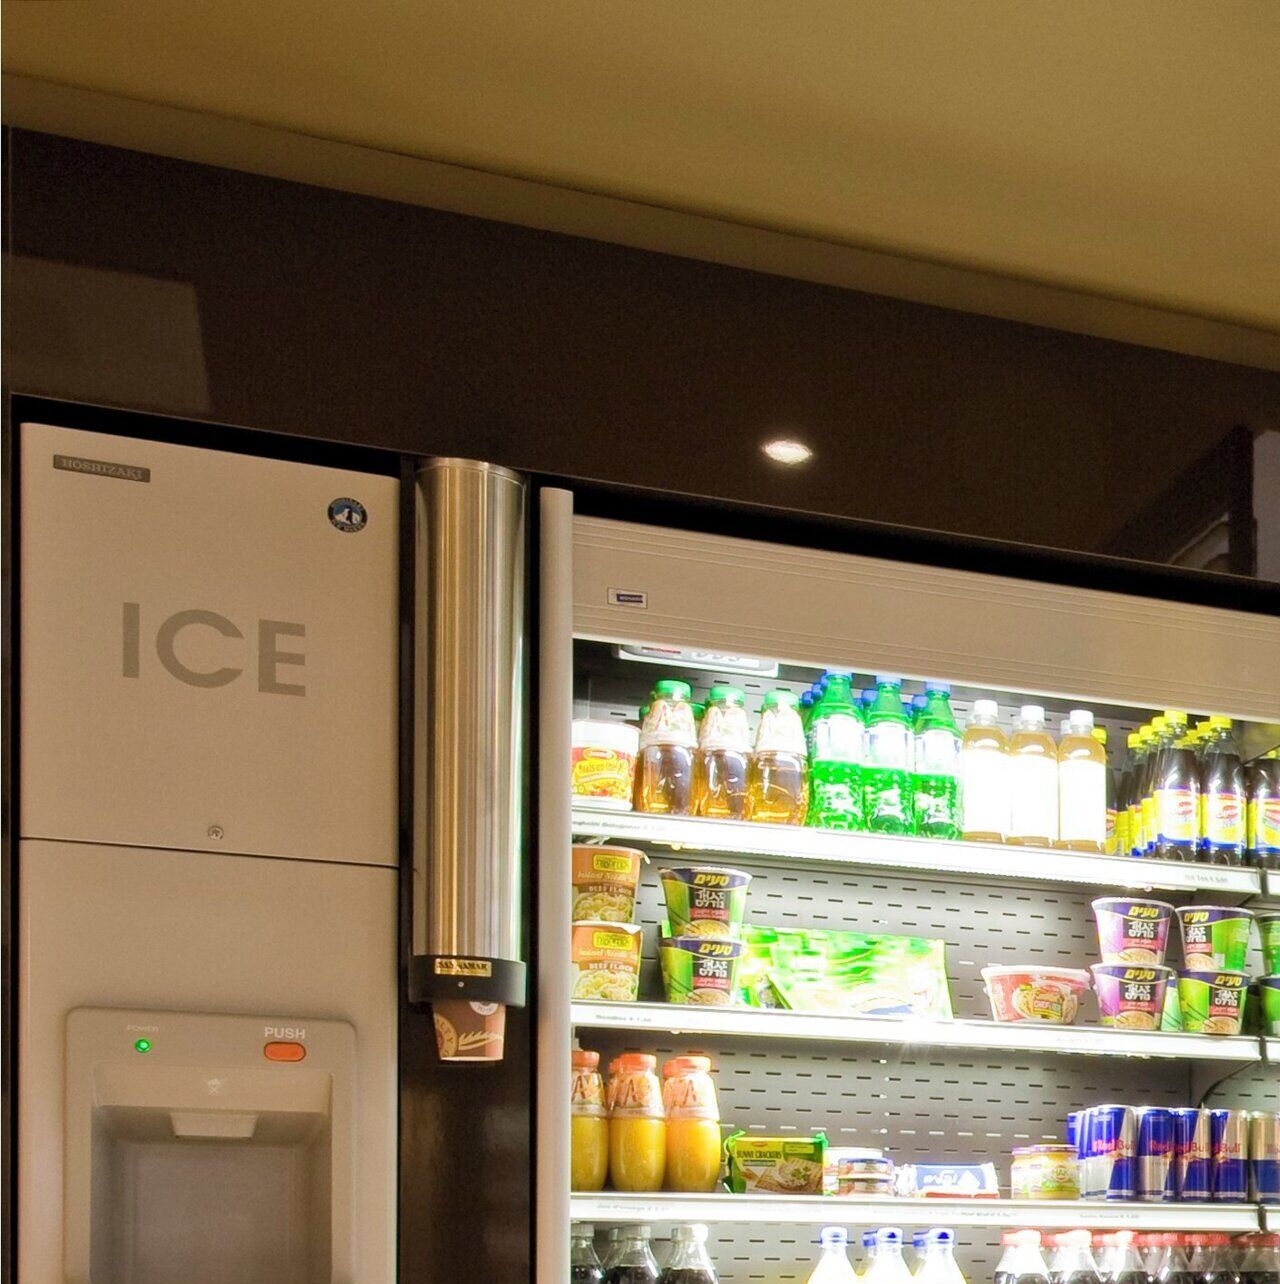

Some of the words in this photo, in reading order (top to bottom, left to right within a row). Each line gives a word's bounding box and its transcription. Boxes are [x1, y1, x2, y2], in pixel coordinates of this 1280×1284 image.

[62, 458, 142, 480] HOSHIZAKI
[121, 602, 306, 697] ICE
[126, 1025, 159, 1033] POWER
[264, 1026, 306, 1039] PUSH
[737, 1150, 754, 1158] SUNNY
[755, 1151, 782, 1159] CRACKERS
